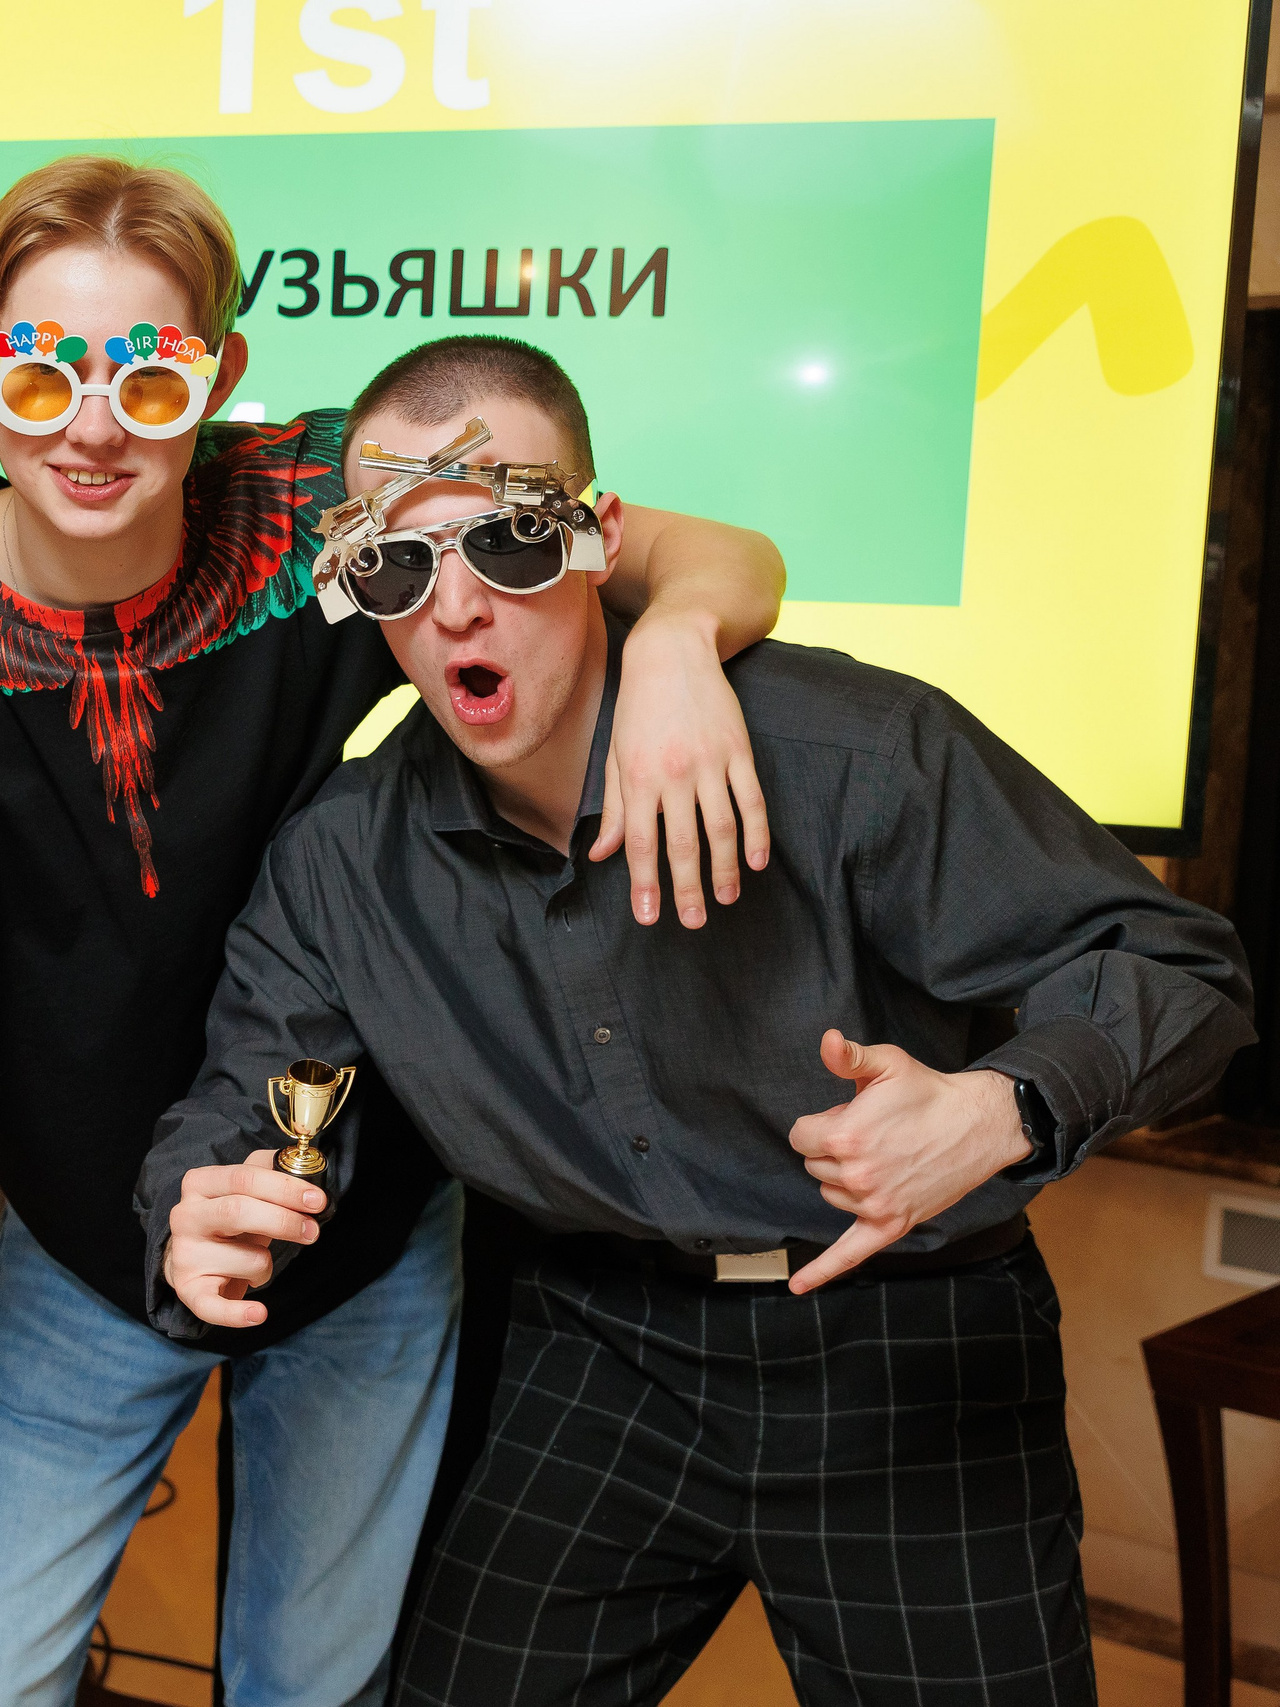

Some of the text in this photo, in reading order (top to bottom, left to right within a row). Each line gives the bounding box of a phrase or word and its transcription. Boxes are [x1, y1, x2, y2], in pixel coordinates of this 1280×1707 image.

[183, 0, 491, 114] 1st
[236, 247, 669, 318] УЗЬЯШКИ
[5, 332, 202, 363] HAPPY BIRTHDAY
